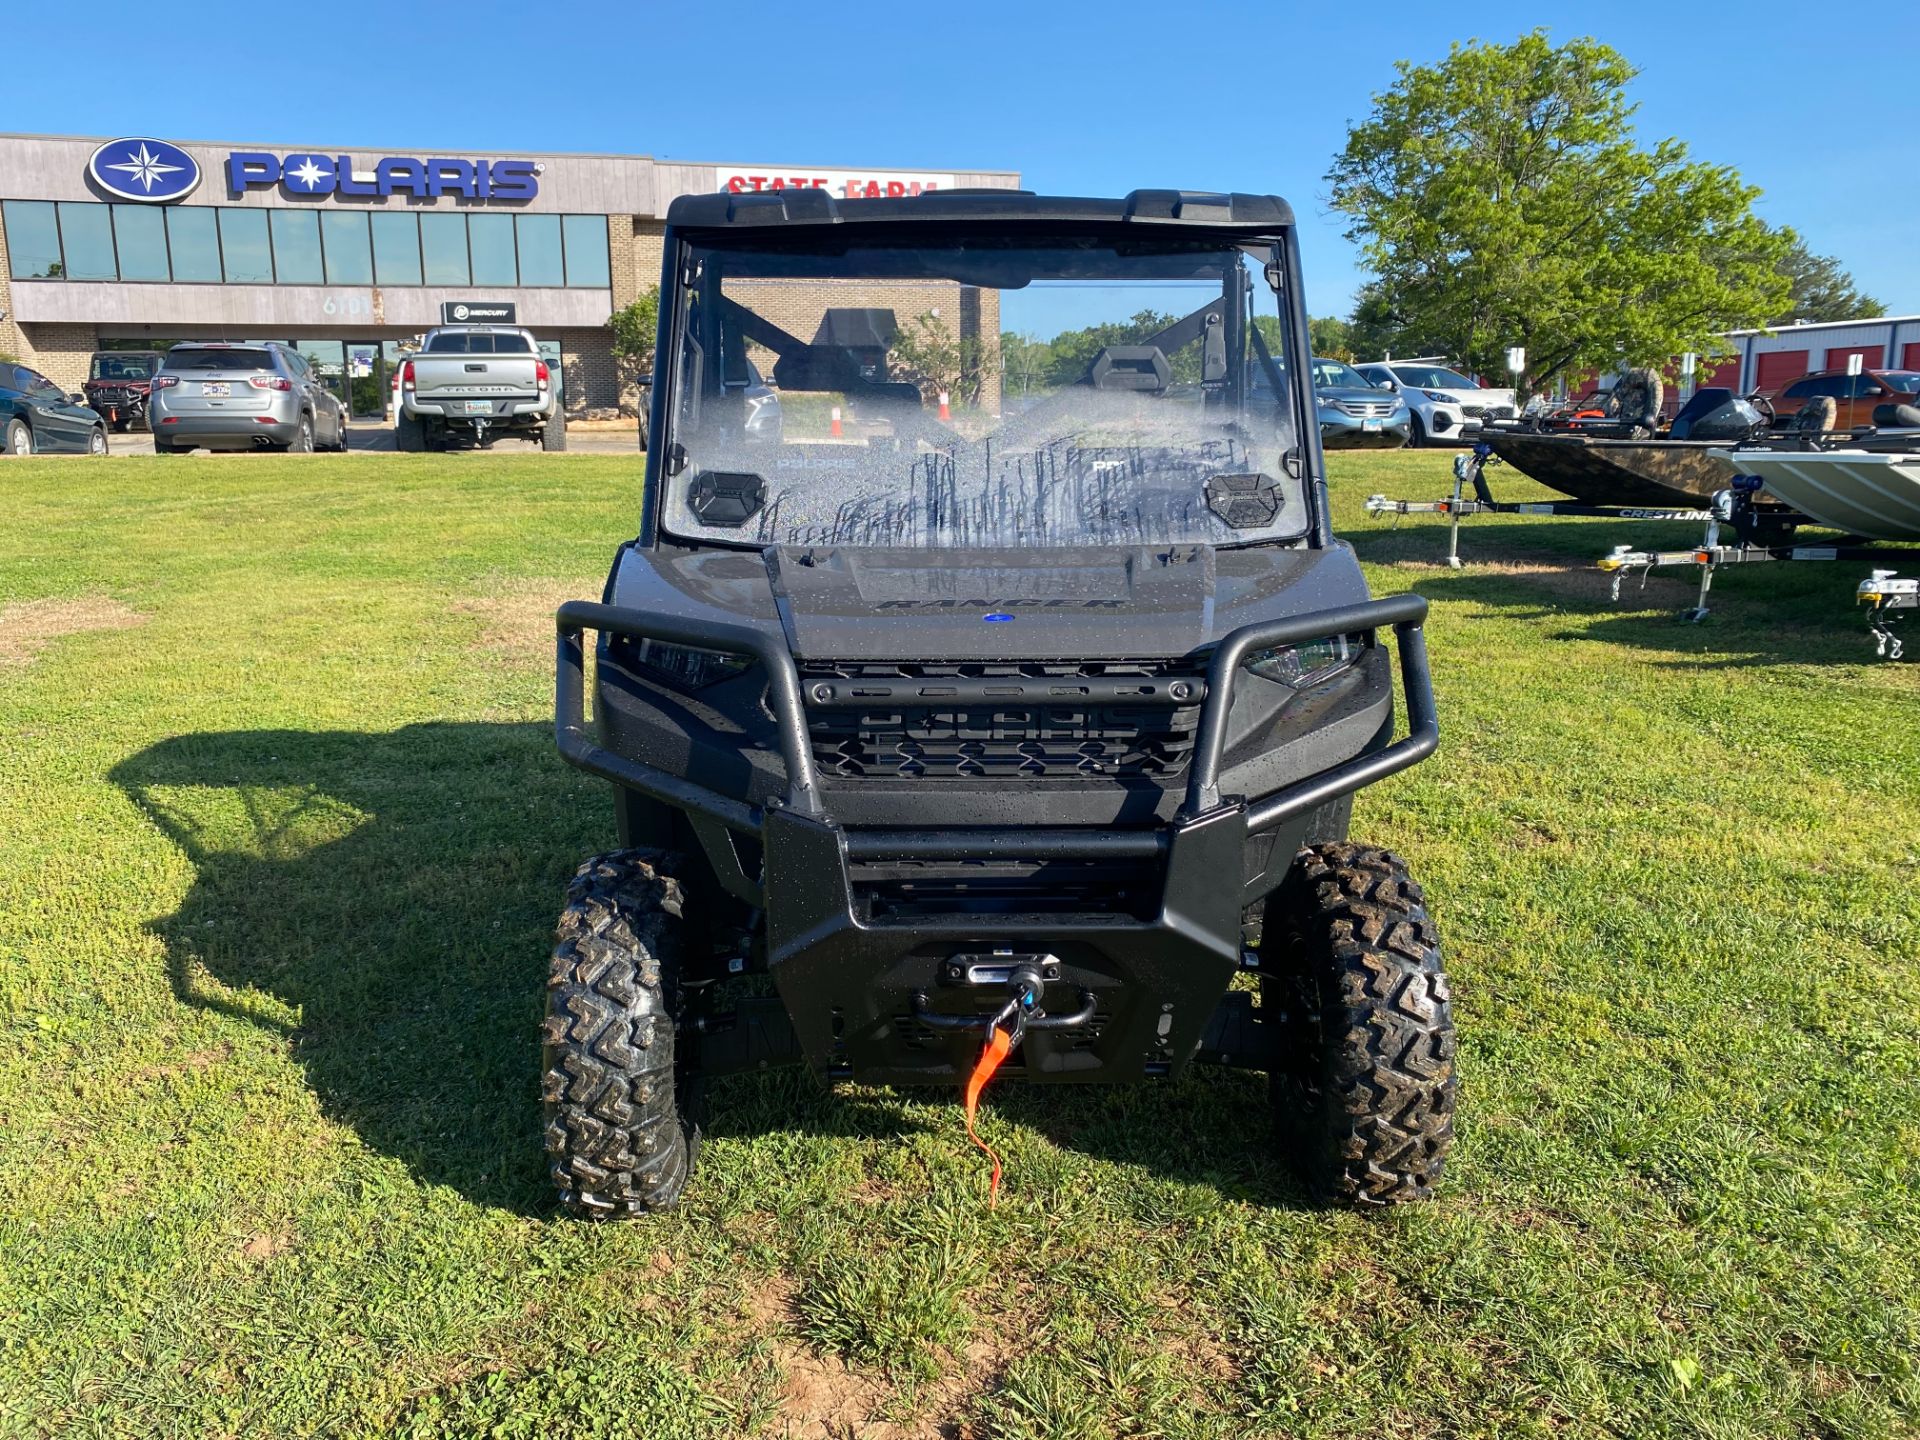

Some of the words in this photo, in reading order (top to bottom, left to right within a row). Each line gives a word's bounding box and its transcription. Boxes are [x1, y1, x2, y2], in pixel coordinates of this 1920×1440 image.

[230, 152, 539, 199] POLARIS
[847, 180, 937, 198] FARM
[1620, 509, 1714, 521] CRESTLINE
[875, 599, 1125, 609] RANGER
[858, 708, 1140, 740] POLARIS
